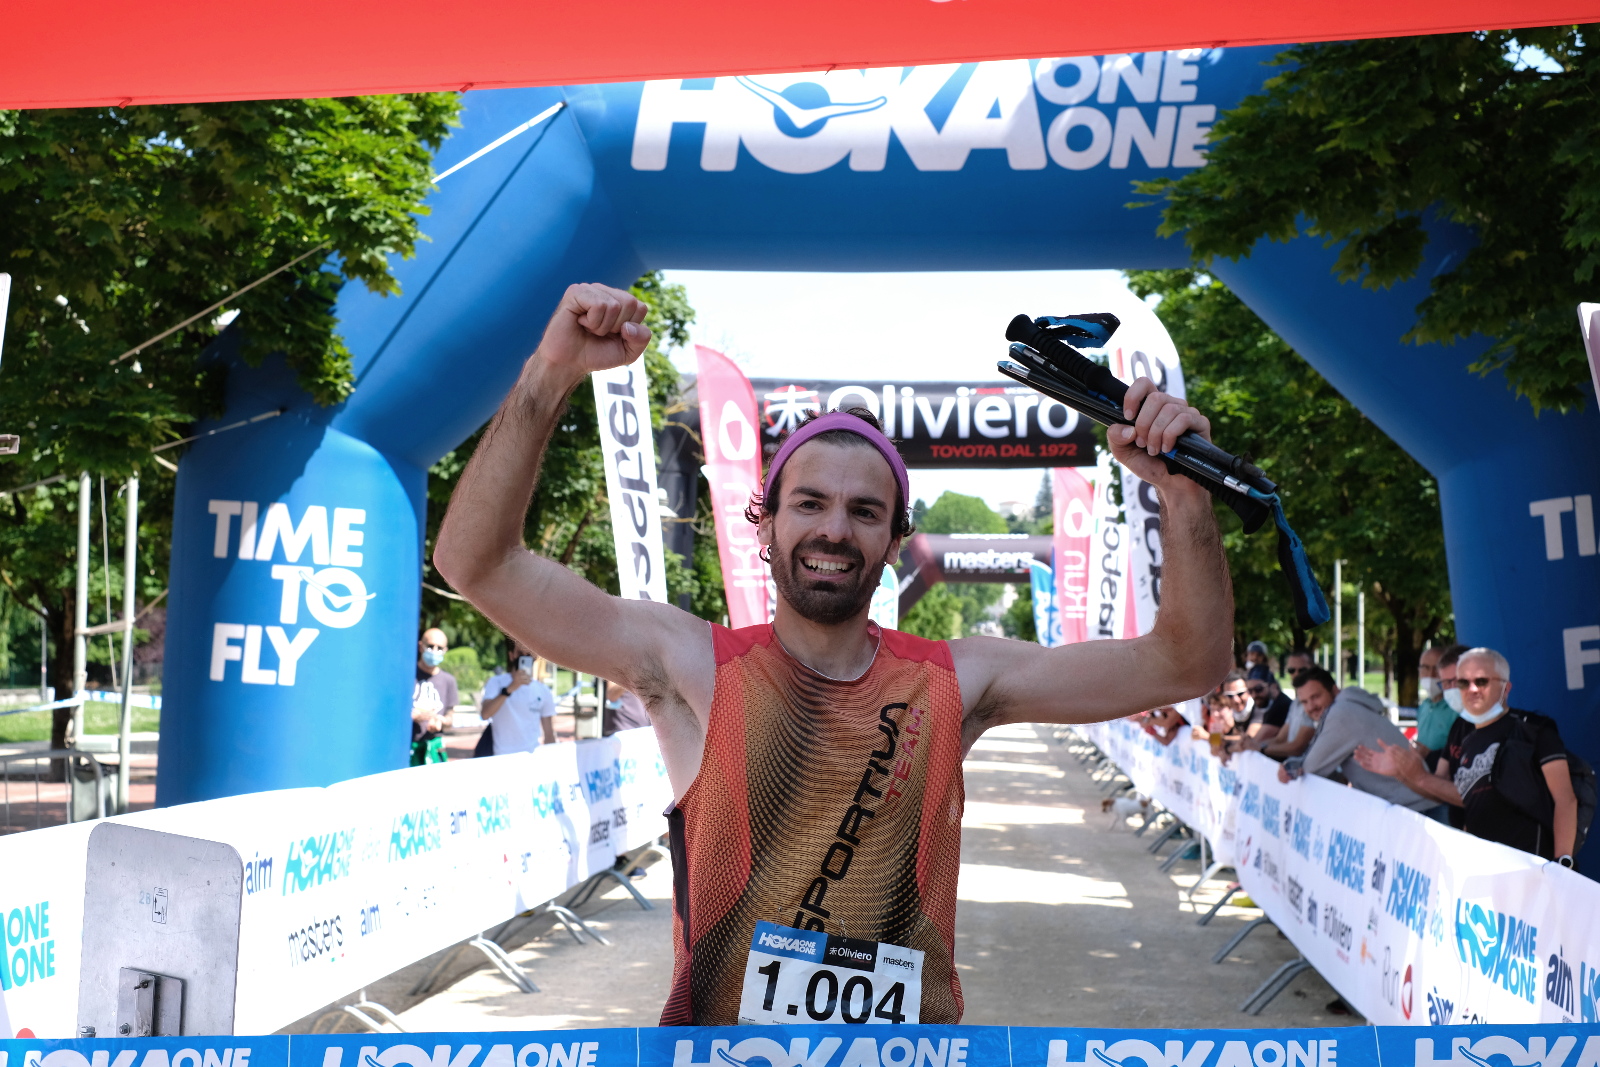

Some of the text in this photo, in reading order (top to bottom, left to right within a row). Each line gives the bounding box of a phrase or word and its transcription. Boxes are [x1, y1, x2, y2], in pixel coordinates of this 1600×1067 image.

[631, 52, 1199, 174] HOKA ONE
[1046, 105, 1216, 170] ONE
[826, 384, 1080, 440] Oliviero
[930, 443, 1078, 458] TOYOTA DAL 1972
[208, 499, 367, 568] TIME
[1529, 494, 1600, 561] TI
[944, 549, 1034, 569] masters
[271, 564, 377, 629] TO
[209, 622, 320, 687] FLY
[885, 707, 924, 803] TEAM
[245, 851, 273, 895] aim
[282, 832, 338, 896] HOKA
[7, 901, 50, 947] ONE
[288, 914, 344, 968] masters
[758, 931, 817, 952] HOKA ONE
[1455, 898, 1516, 991] HOKA
[1512, 919, 1538, 964] ONE
[12, 939, 56, 987] ONE
[799, 946, 817, 956] ONE
[837, 947, 873, 961] Oliviero
[882, 956, 915, 969] masters
[758, 960, 906, 1024] 1.004
[1427, 985, 1454, 1025] aim
[1508, 957, 1538, 1005] ONE
[1545, 943, 1575, 1017] aim
[880, 1037, 970, 1067] ONE
[1252, 1039, 1338, 1067] ONE
